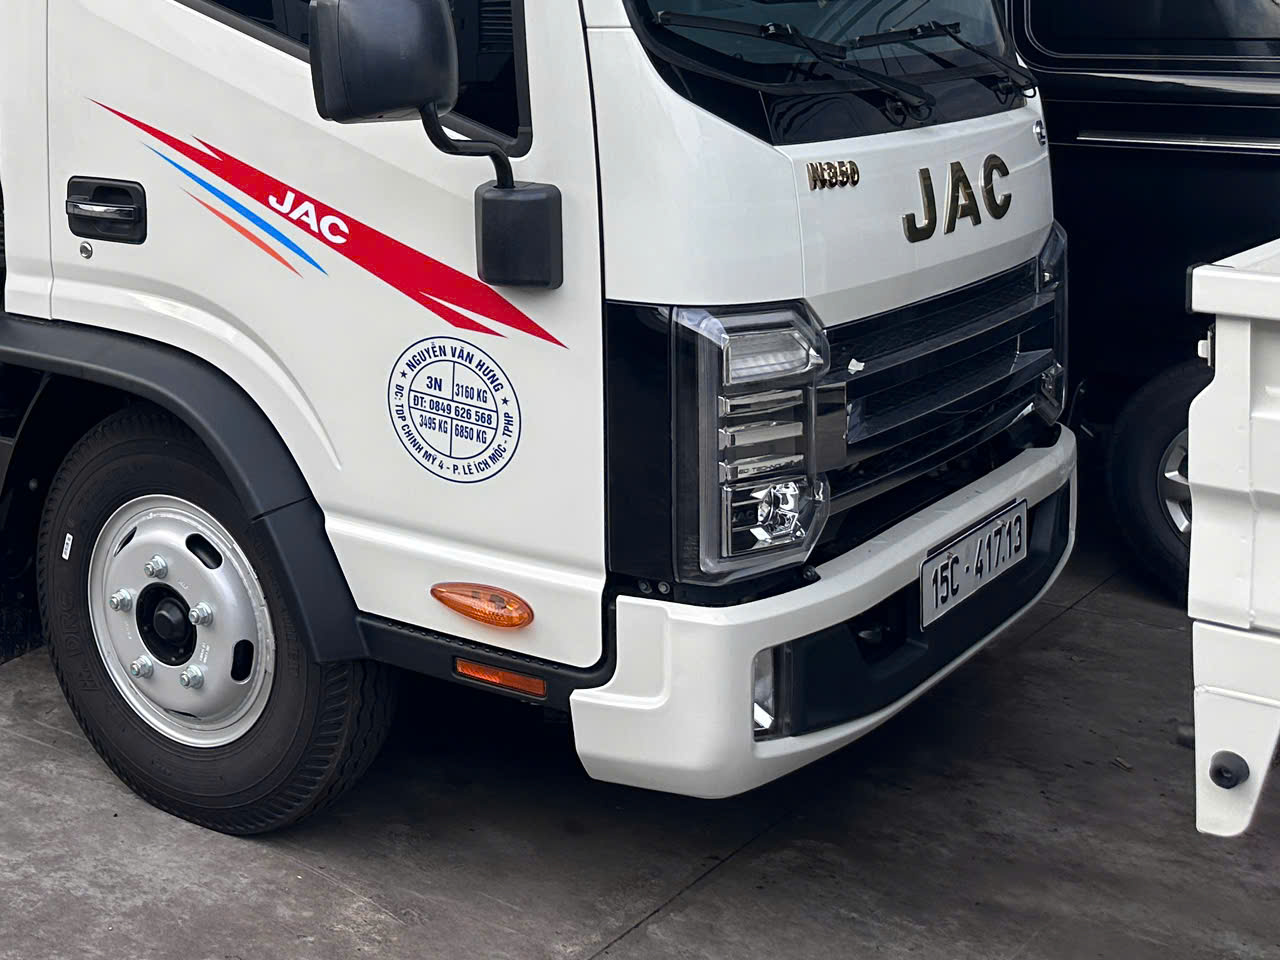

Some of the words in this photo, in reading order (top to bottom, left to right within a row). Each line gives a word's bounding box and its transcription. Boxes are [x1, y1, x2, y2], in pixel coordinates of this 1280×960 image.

[902, 153, 1012, 244] JAC
[268, 190, 350, 245] JAC
[405, 341, 447, 372] NGUYỄN
[450, 345, 475, 365] VĂN
[475, 359, 504, 393] HƯNG
[426, 375, 443, 392] 3N
[455, 383, 475, 400] 3160
[476, 387, 488, 404] KG
[419, 414, 437, 431] 3495
[438, 419, 449, 435] KG
[429, 398, 452, 415] 0849
[454, 405, 472, 420] 626
[474, 410, 493, 426] 568
[394, 403, 407, 422] TDP
[401, 423, 424, 454] CHINH
[501, 412, 514, 438] TPHP
[454, 423, 474, 441] 6850
[476, 428, 487, 444] KG
